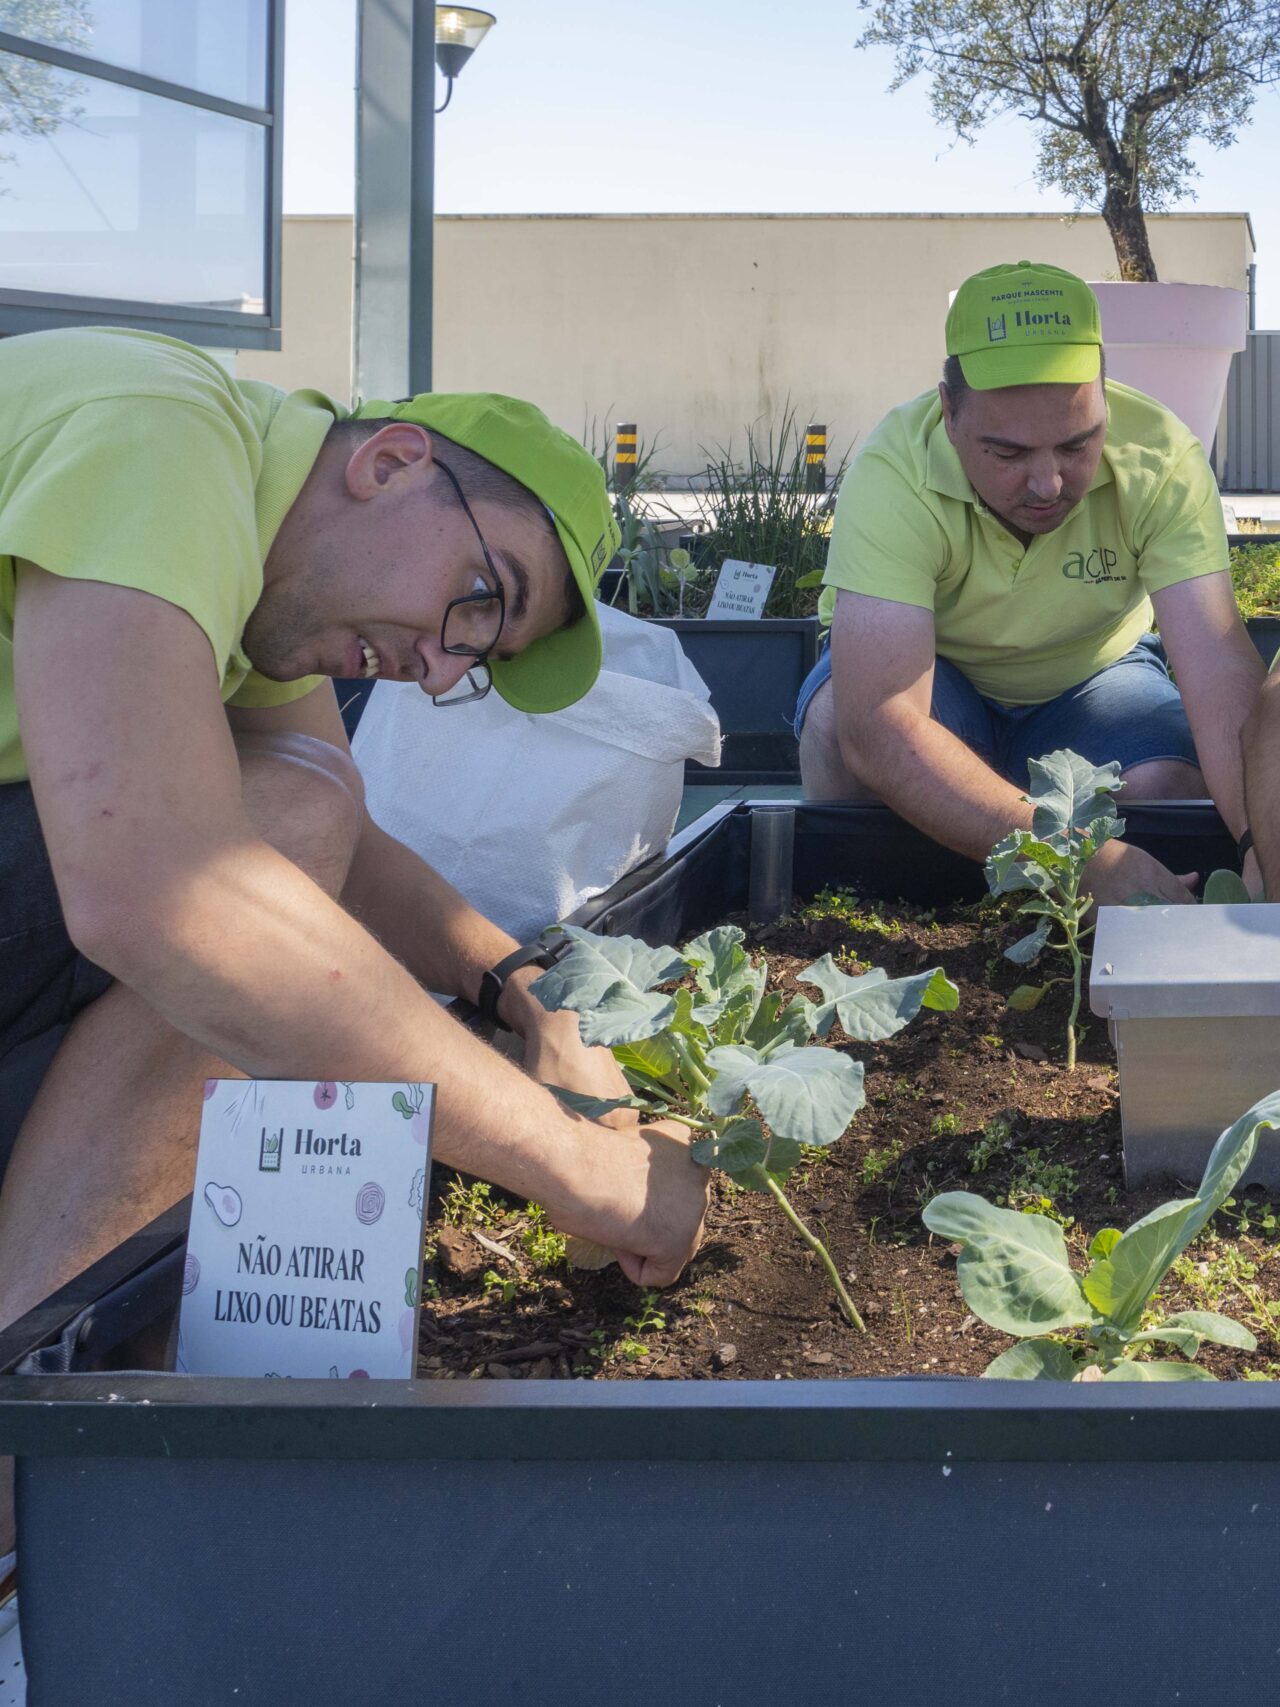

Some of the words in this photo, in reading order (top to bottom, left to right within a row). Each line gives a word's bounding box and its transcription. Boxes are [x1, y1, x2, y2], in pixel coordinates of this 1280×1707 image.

[991, 290, 1022, 302] PARQUE
[1024, 289, 1064, 297] NASCENTE
[1016, 310, 1072, 327] Horta
[294, 1128, 362, 1157] Horta
[301, 1164, 351, 1176] URBANA
[236, 1234, 282, 1276] NÃO
[285, 1246, 365, 1284] ATIRAR
[214, 1289, 262, 1324] LIXO
[266, 1293, 295, 1326] OU
[298, 1295, 382, 1335] BEATAS
